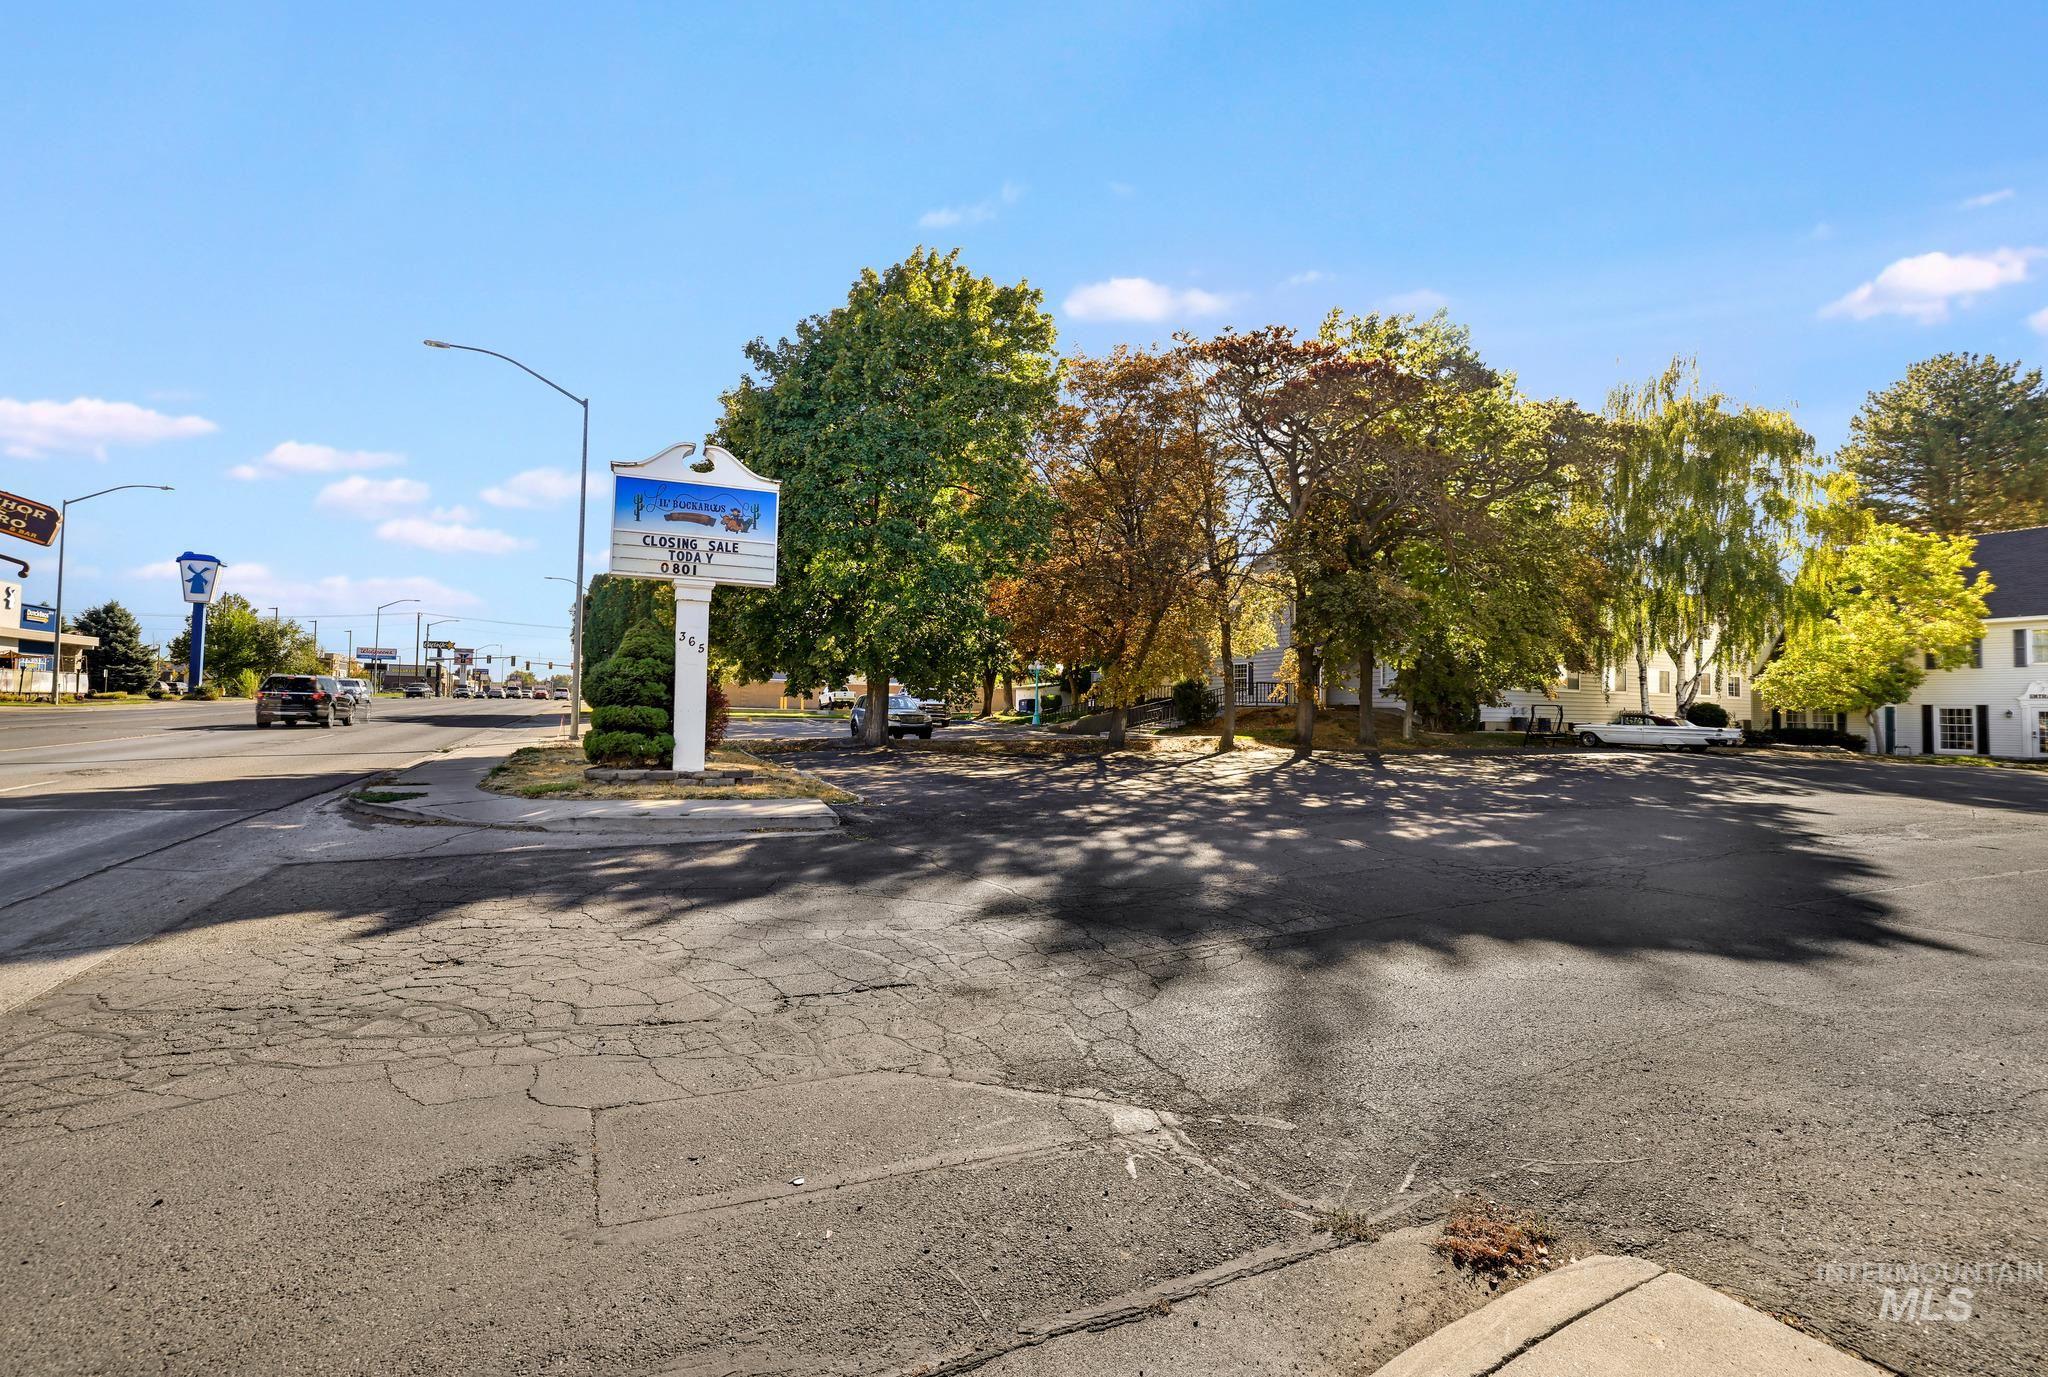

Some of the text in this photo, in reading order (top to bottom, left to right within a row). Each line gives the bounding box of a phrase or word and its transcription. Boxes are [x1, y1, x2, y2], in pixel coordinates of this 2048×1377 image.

[0, 498, 47, 520] HOR
[642, 535, 739, 553] CLOSING SALE
[668, 550, 714, 564] TODAY
[679, 631, 705, 654] 365
